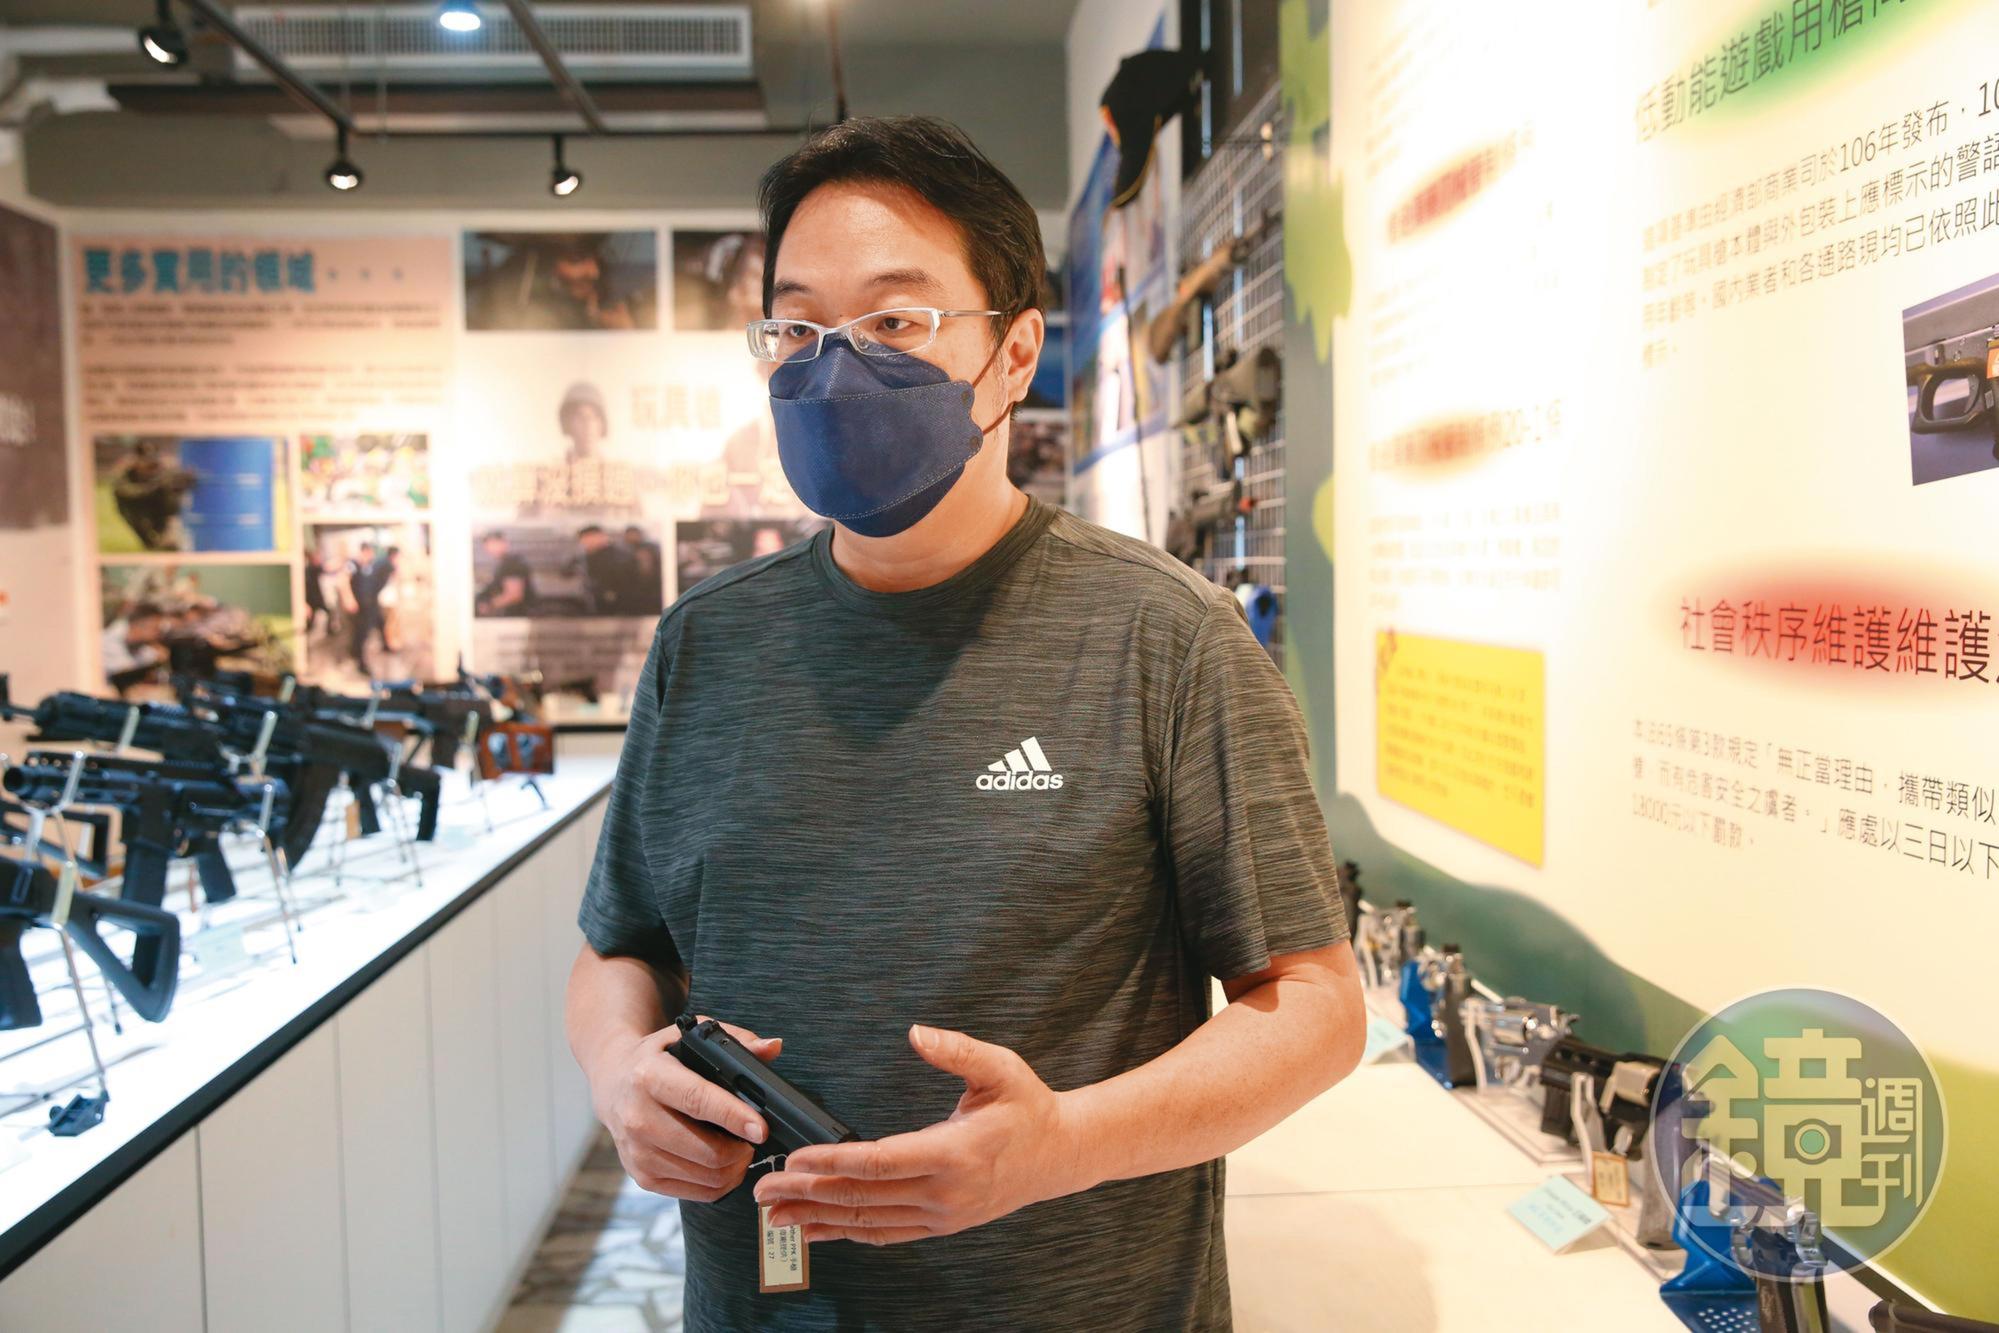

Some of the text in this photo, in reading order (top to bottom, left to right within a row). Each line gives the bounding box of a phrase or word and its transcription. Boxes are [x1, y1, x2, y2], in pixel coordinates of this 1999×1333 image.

[1636, 0, 1904, 143] 低動能遊戲用槍
[1680, 596, 1999, 685] 社會秩序維護維護
[975, 770, 1064, 791] adidas
